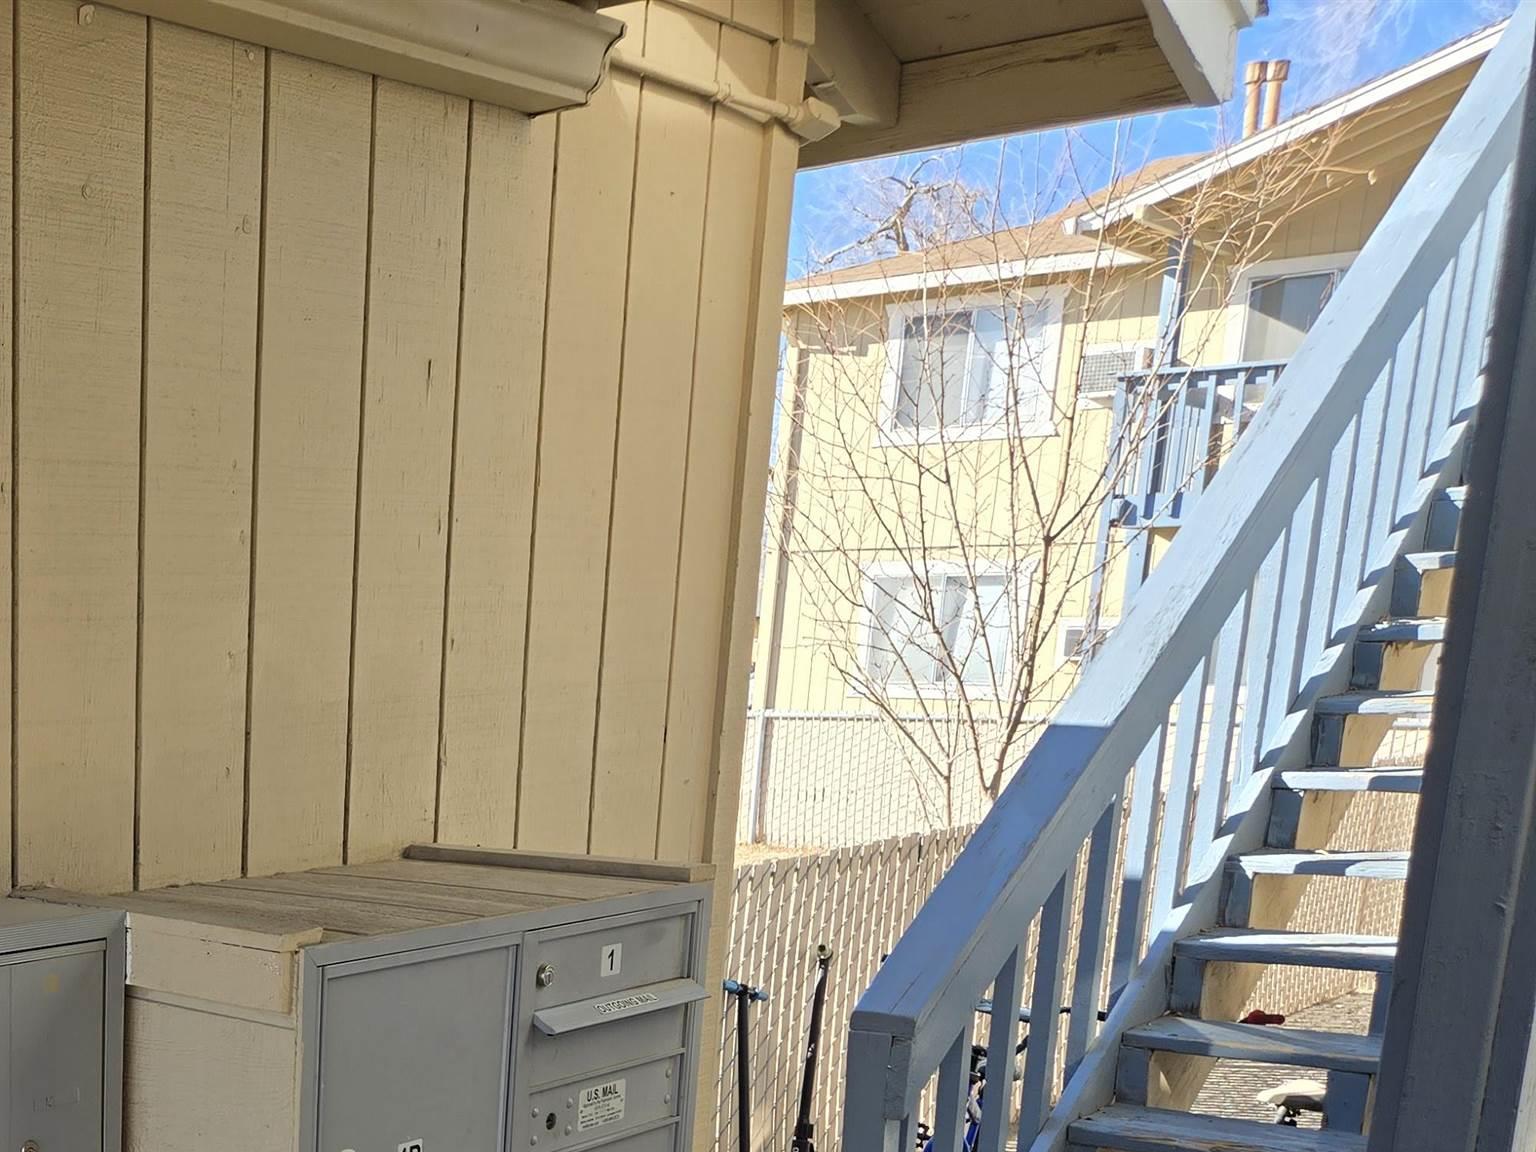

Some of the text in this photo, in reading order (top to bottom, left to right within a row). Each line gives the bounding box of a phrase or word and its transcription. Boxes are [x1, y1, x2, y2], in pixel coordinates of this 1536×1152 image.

[607, 948, 615, 971] 1
[594, 993, 658, 1015] OUTGOING MAIL
[586, 1088, 600, 1102] U.S.
[602, 1083, 619, 1097] MAIL
